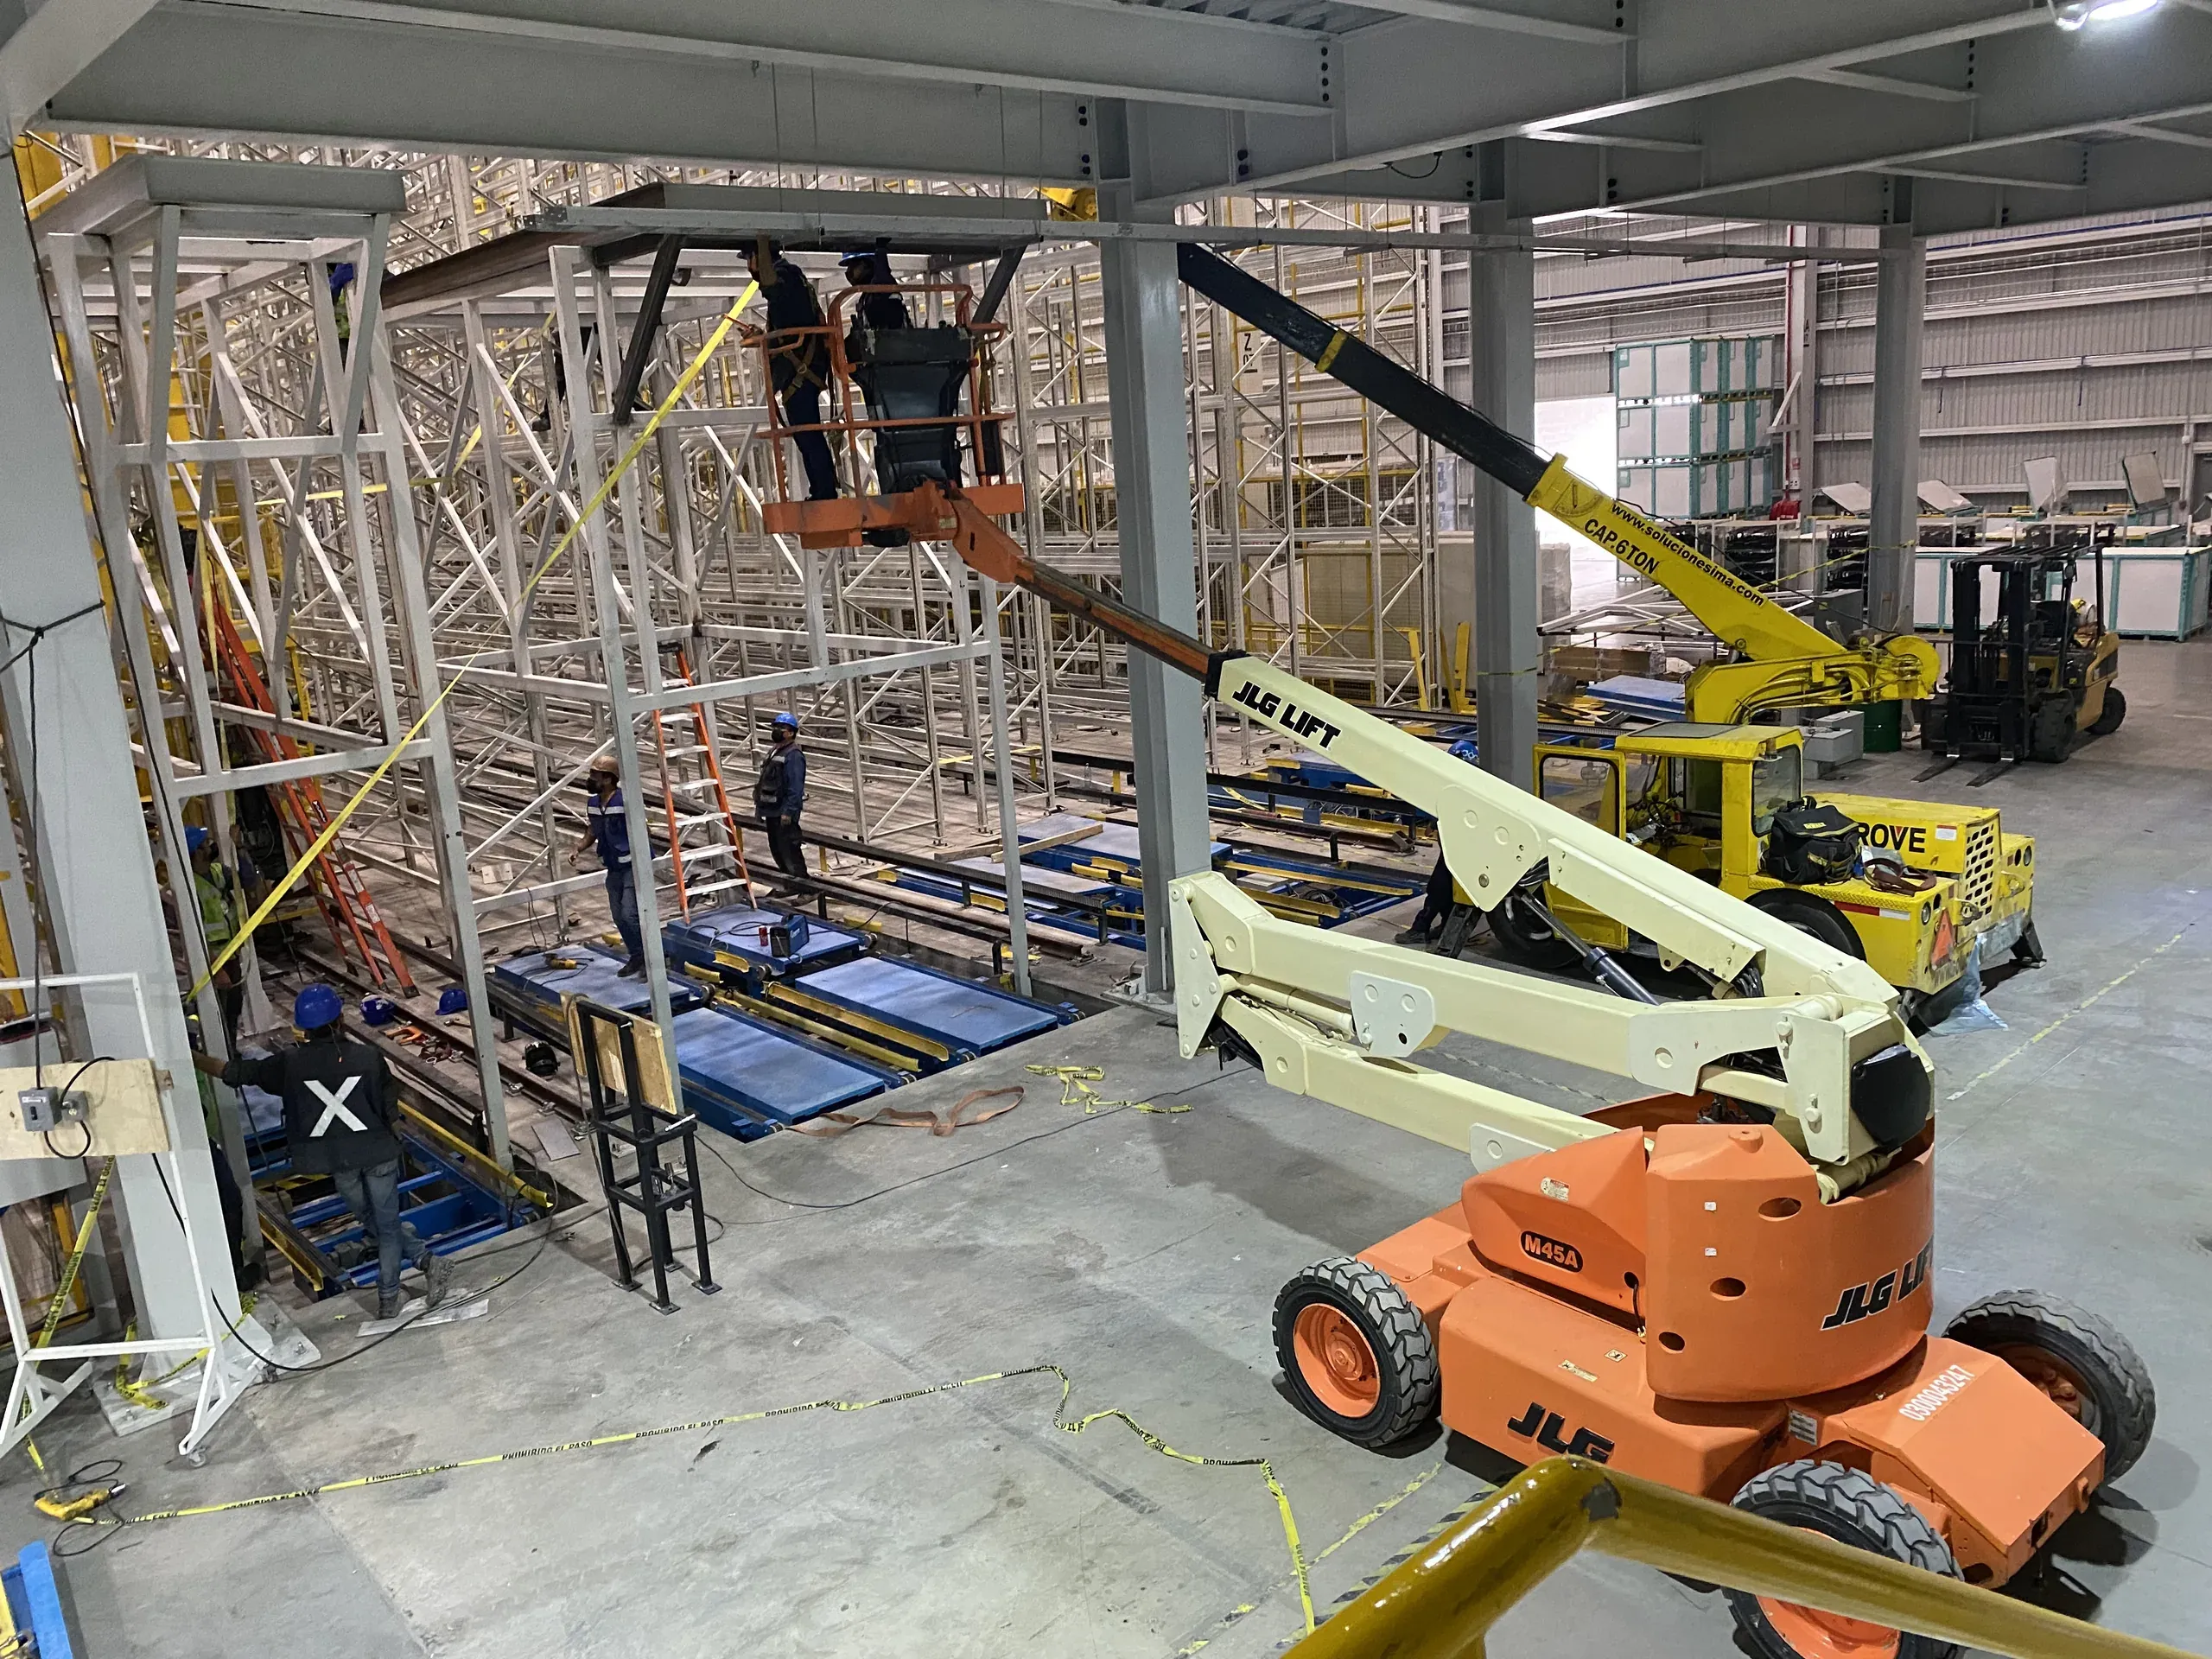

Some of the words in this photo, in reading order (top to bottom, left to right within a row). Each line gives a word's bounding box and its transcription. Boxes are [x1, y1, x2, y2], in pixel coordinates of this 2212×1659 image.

[1244, 333, 1252, 352] Z
[1611, 503, 1764, 606] www.solucionesima.com
[1231, 680, 1282, 719] JLG
[1278, 702, 1342, 749] LIFT
[1858, 821, 1926, 853] ROVE
[303, 1075, 368, 1137] X
[1524, 1234, 1579, 1268] M45A
[1821, 1268, 1898, 1331] JLG
[1897, 1234, 1934, 1303] LIF
[1898, 1364, 1975, 1421] 0300043247
[1507, 1402, 1616, 1465] JLG
